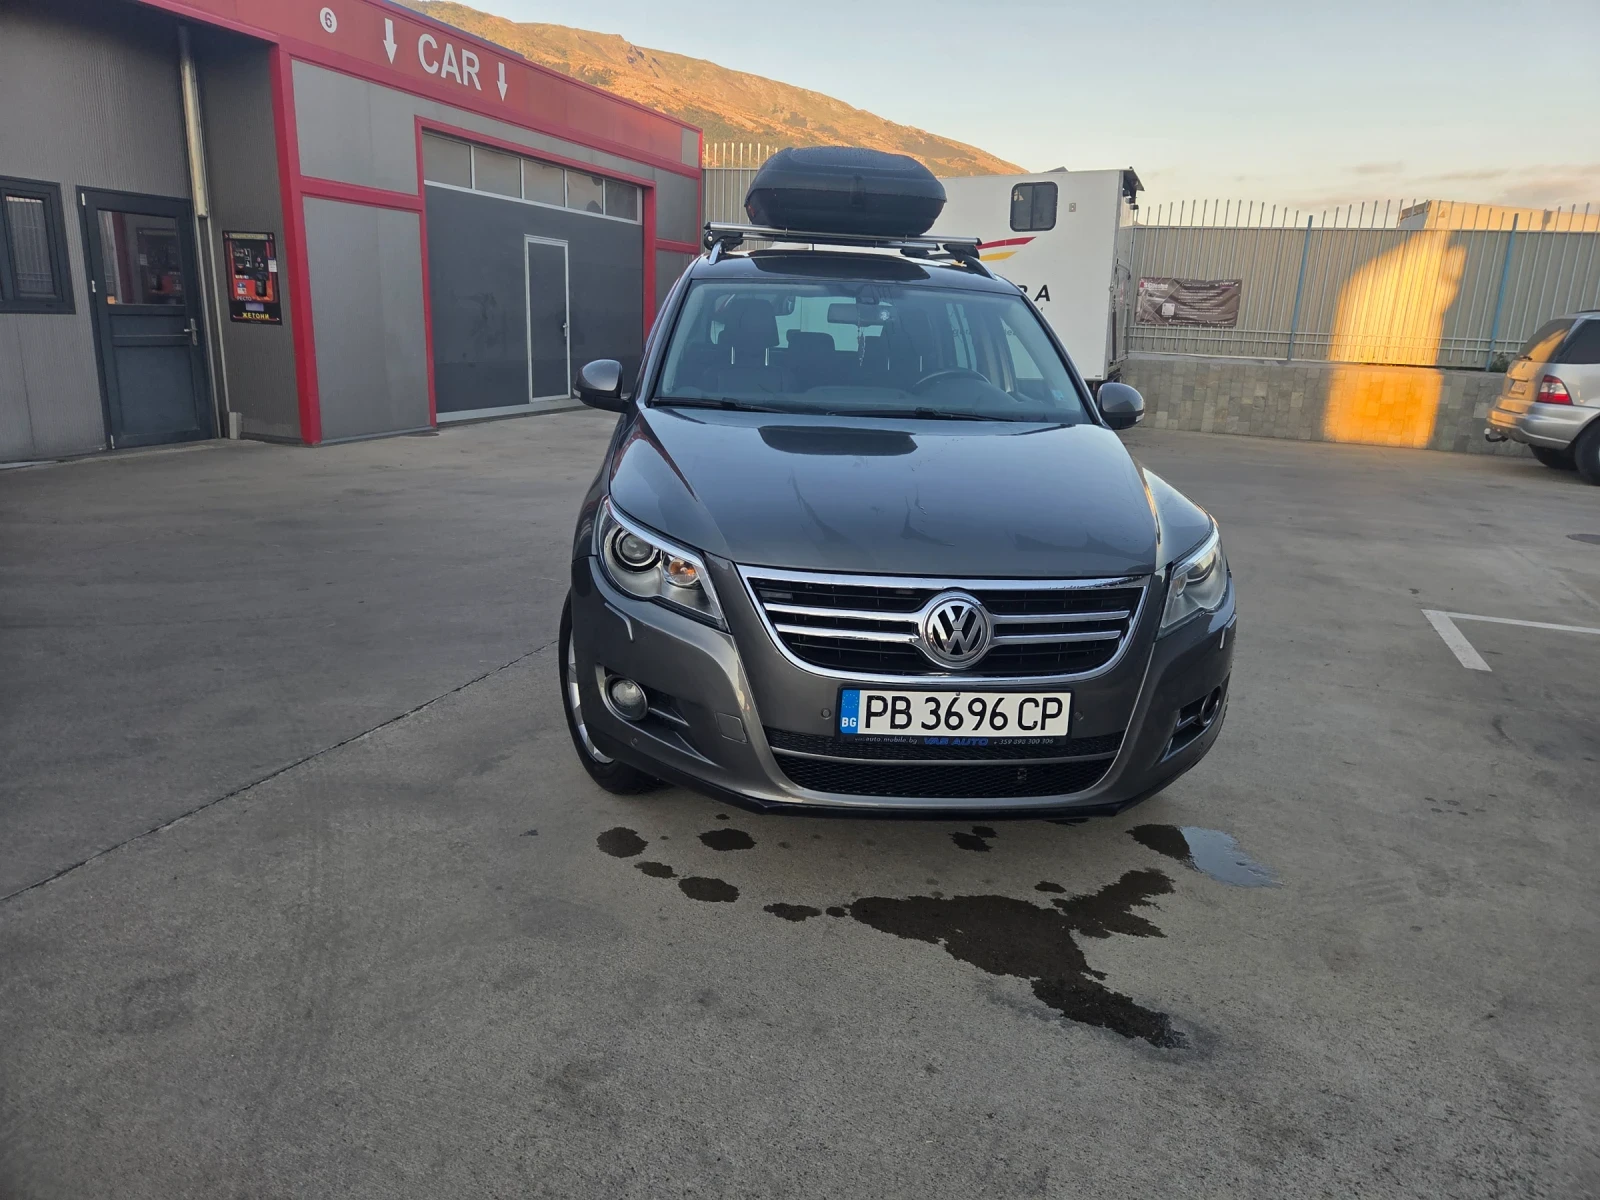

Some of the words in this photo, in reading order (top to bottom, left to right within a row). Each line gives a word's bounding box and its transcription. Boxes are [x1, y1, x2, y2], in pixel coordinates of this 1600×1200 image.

[324, 12, 333, 29] 6
[418, 33, 482, 91] CAR
[865, 695, 912, 730] PB
[921, 697, 1009, 731] 3696
[1017, 697, 1063, 731] CP
[841, 716, 857, 728] BG
[951, 738, 989, 746] AUTO
